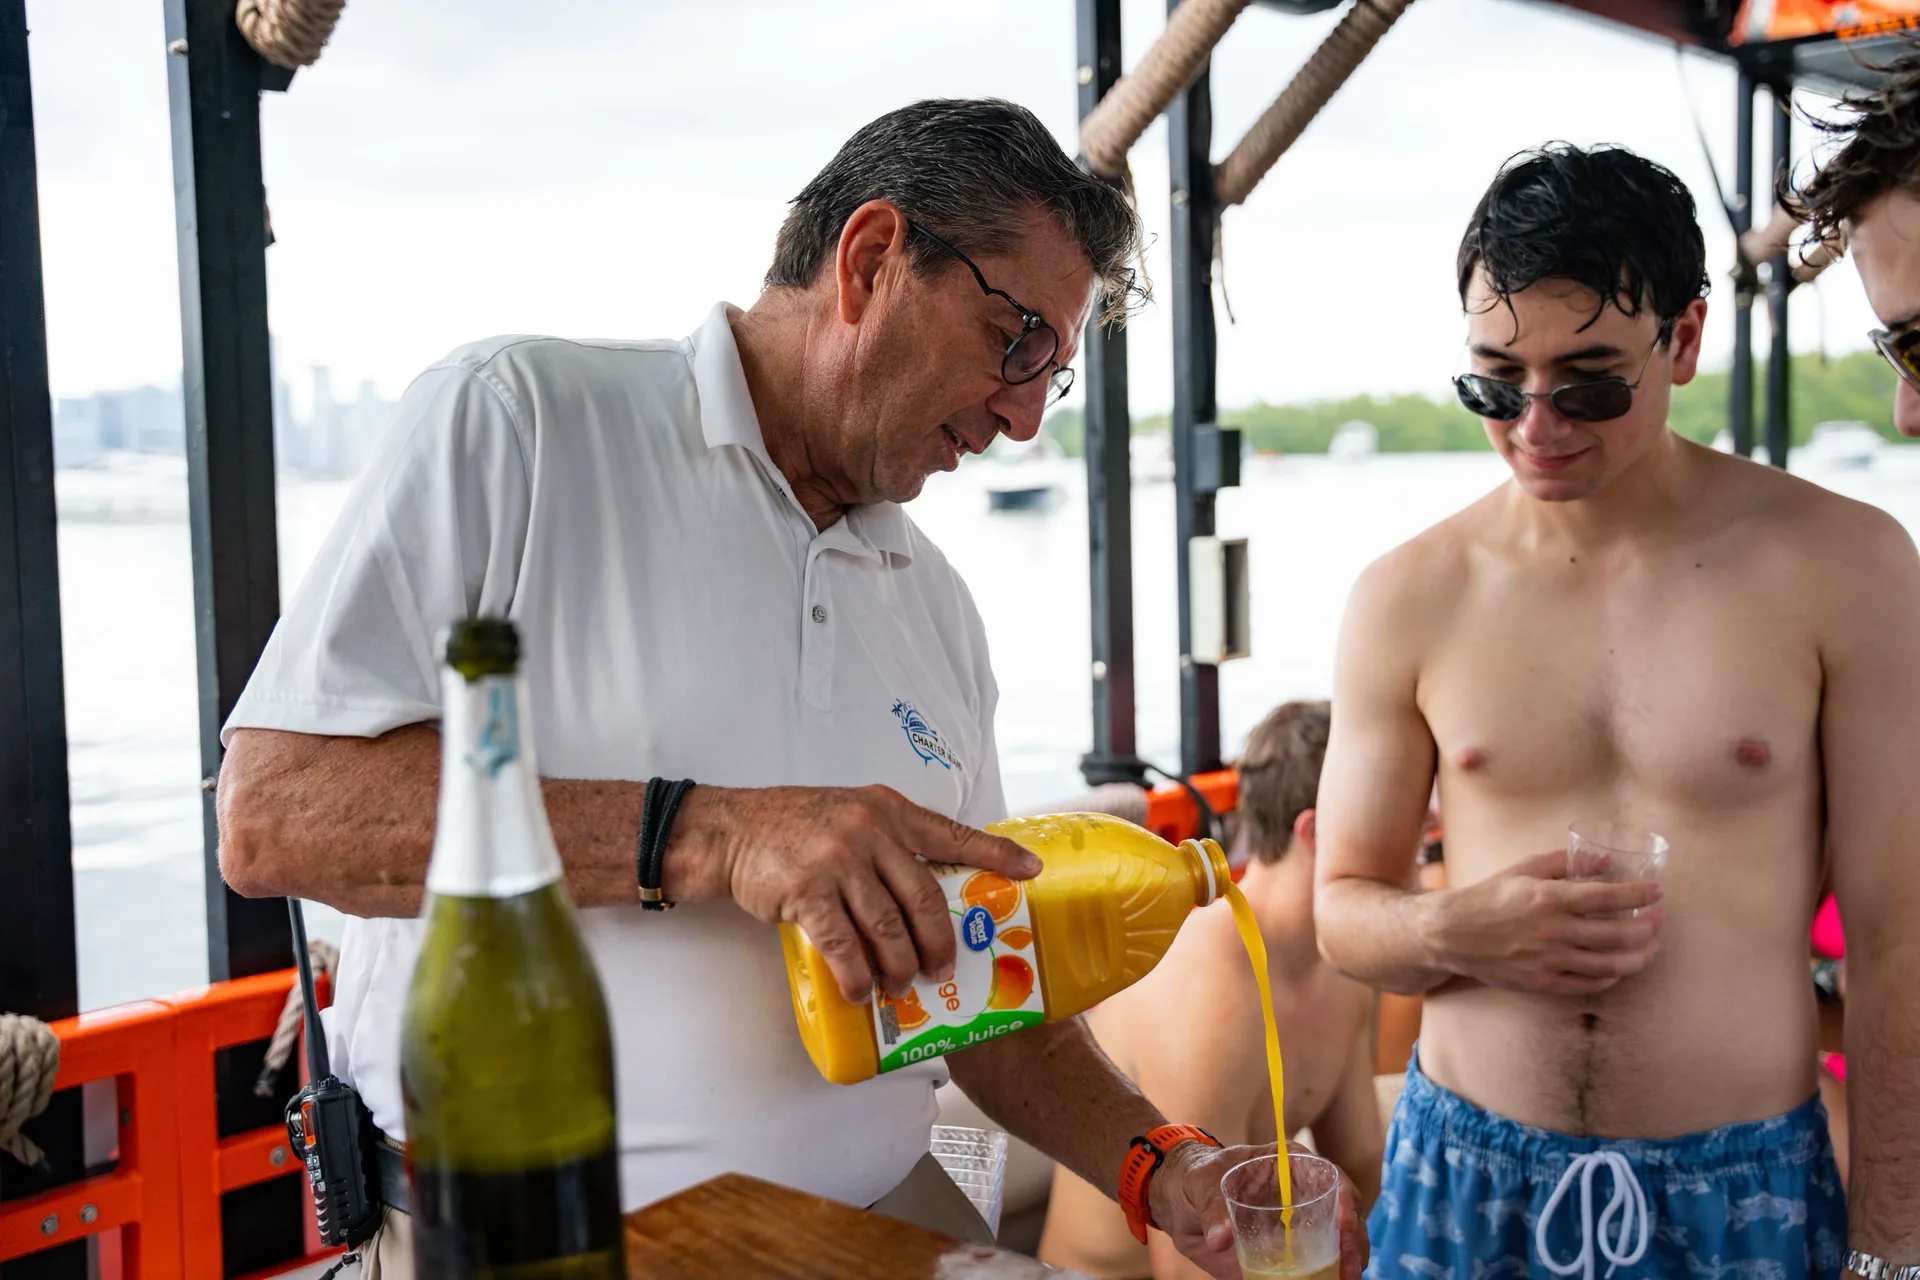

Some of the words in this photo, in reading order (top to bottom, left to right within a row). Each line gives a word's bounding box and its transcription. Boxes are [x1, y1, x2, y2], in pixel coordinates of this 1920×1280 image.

[912, 732, 947, 758] CHARTER
[969, 920, 978, 945] Value
[974, 911, 988, 944] Great
[938, 976, 960, 1011] ge
[901, 1037, 957, 1064] 100%
[963, 1020, 1024, 1045] Juice
